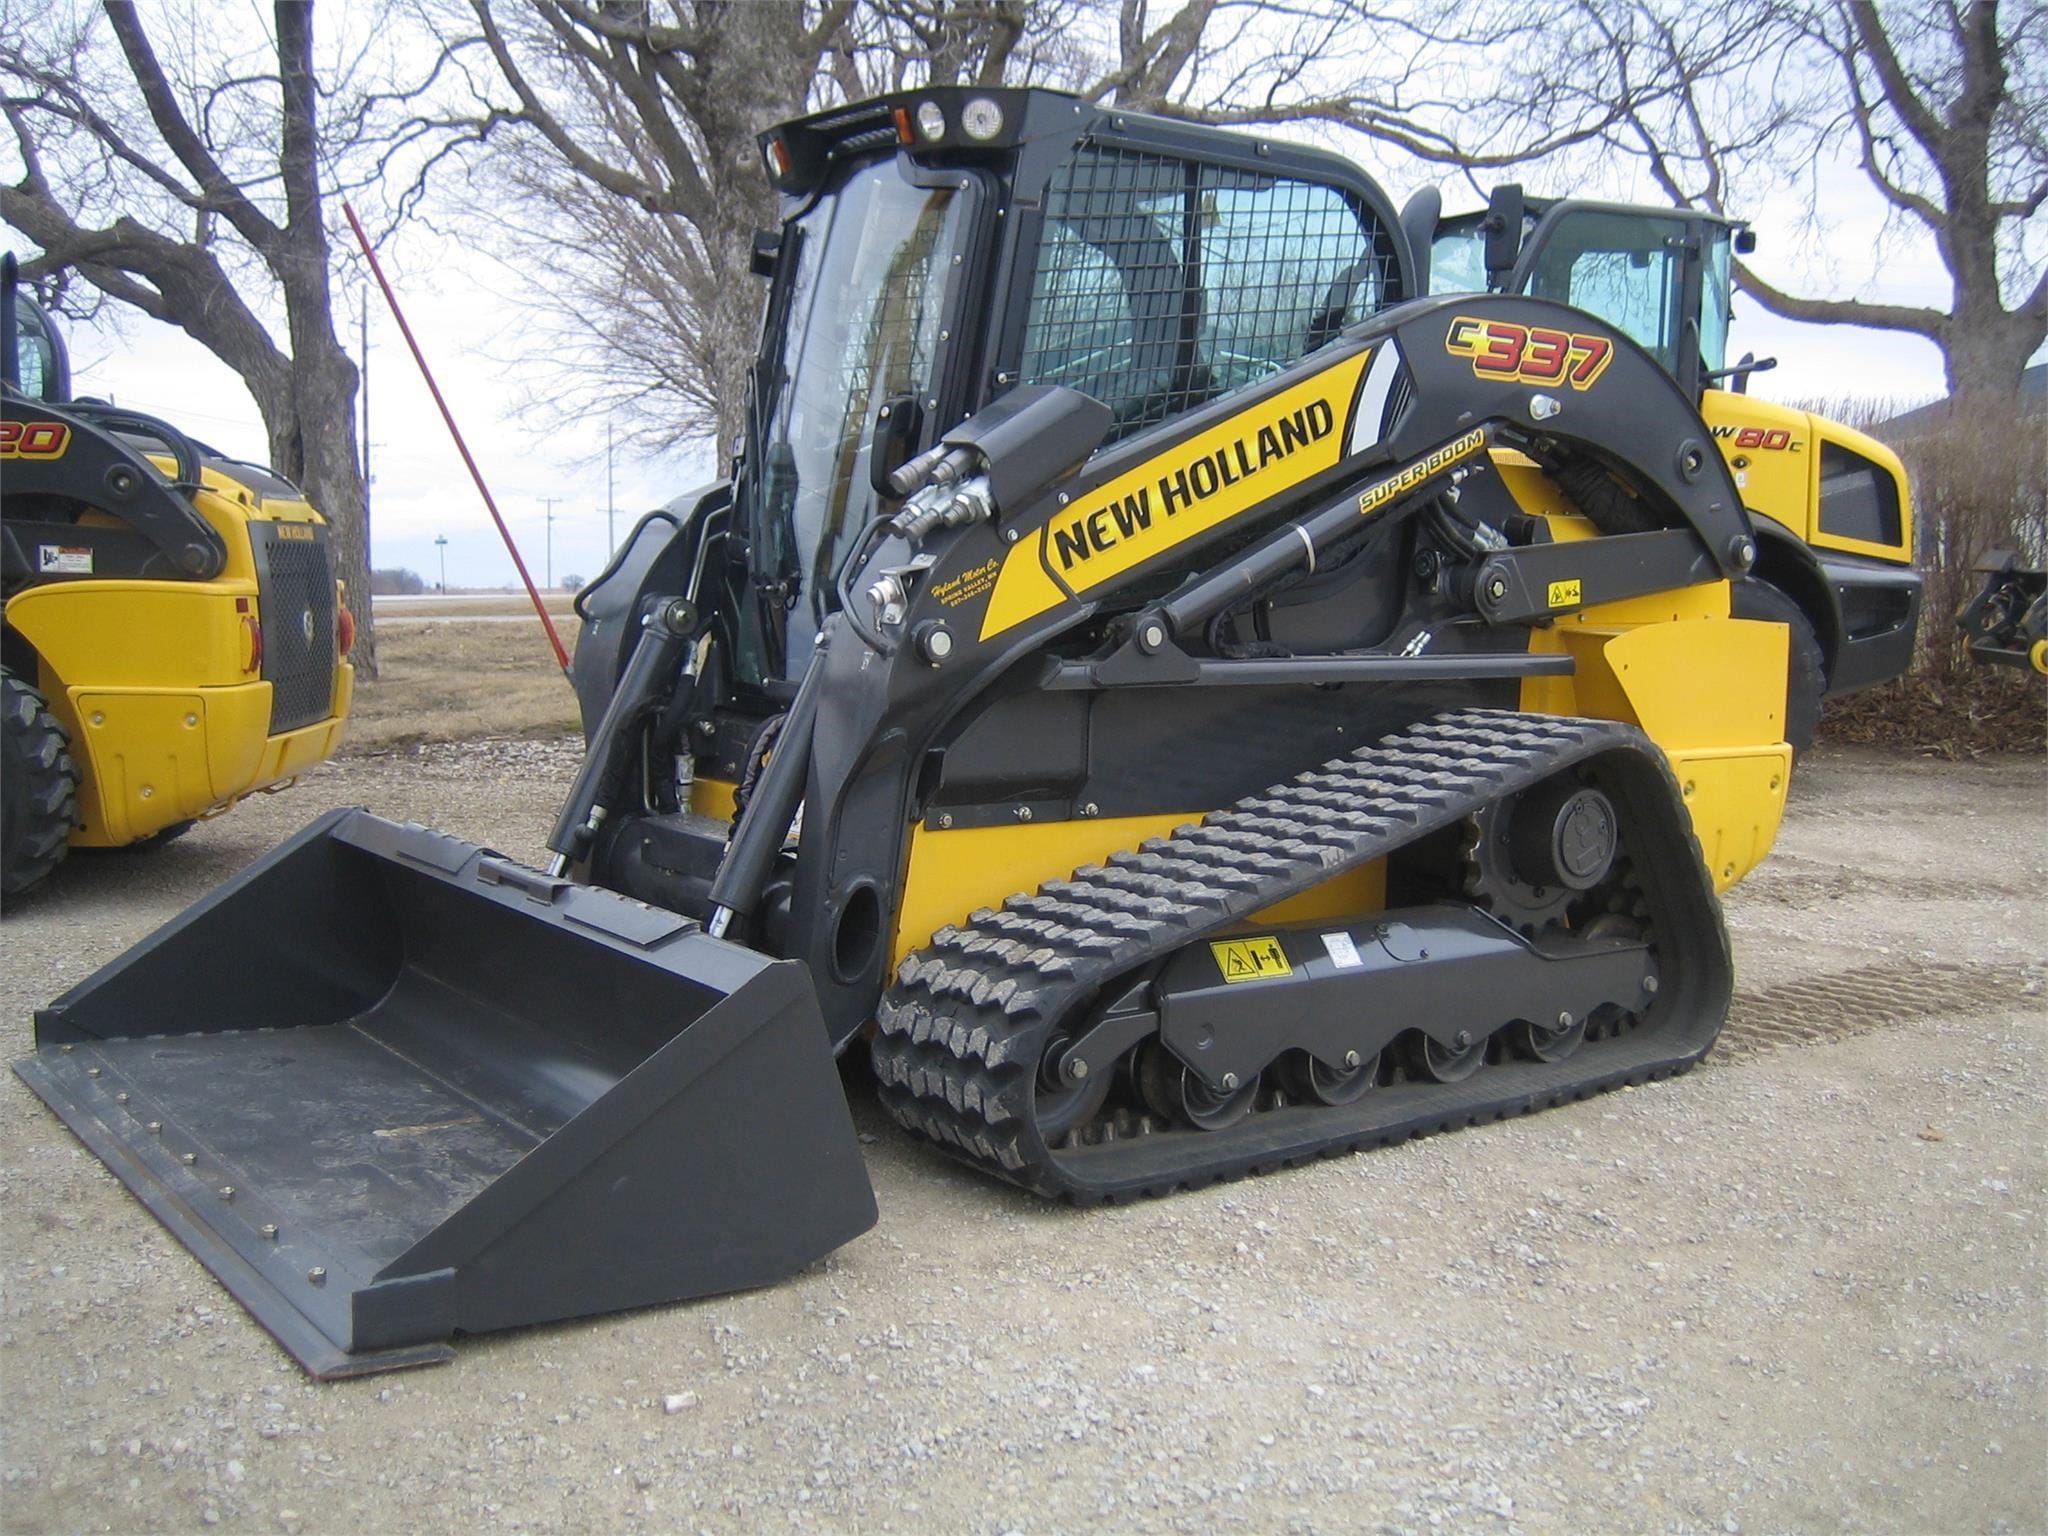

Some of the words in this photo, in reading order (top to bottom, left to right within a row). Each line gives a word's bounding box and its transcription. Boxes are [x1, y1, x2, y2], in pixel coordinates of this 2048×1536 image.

[1446, 316, 1613, 391] C337
[1054, 486, 1151, 571] NEW
[1158, 398, 1334, 517] HOLLAND
[1360, 461, 1428, 515] SUPER
[1427, 428, 1485, 475] BOOM
